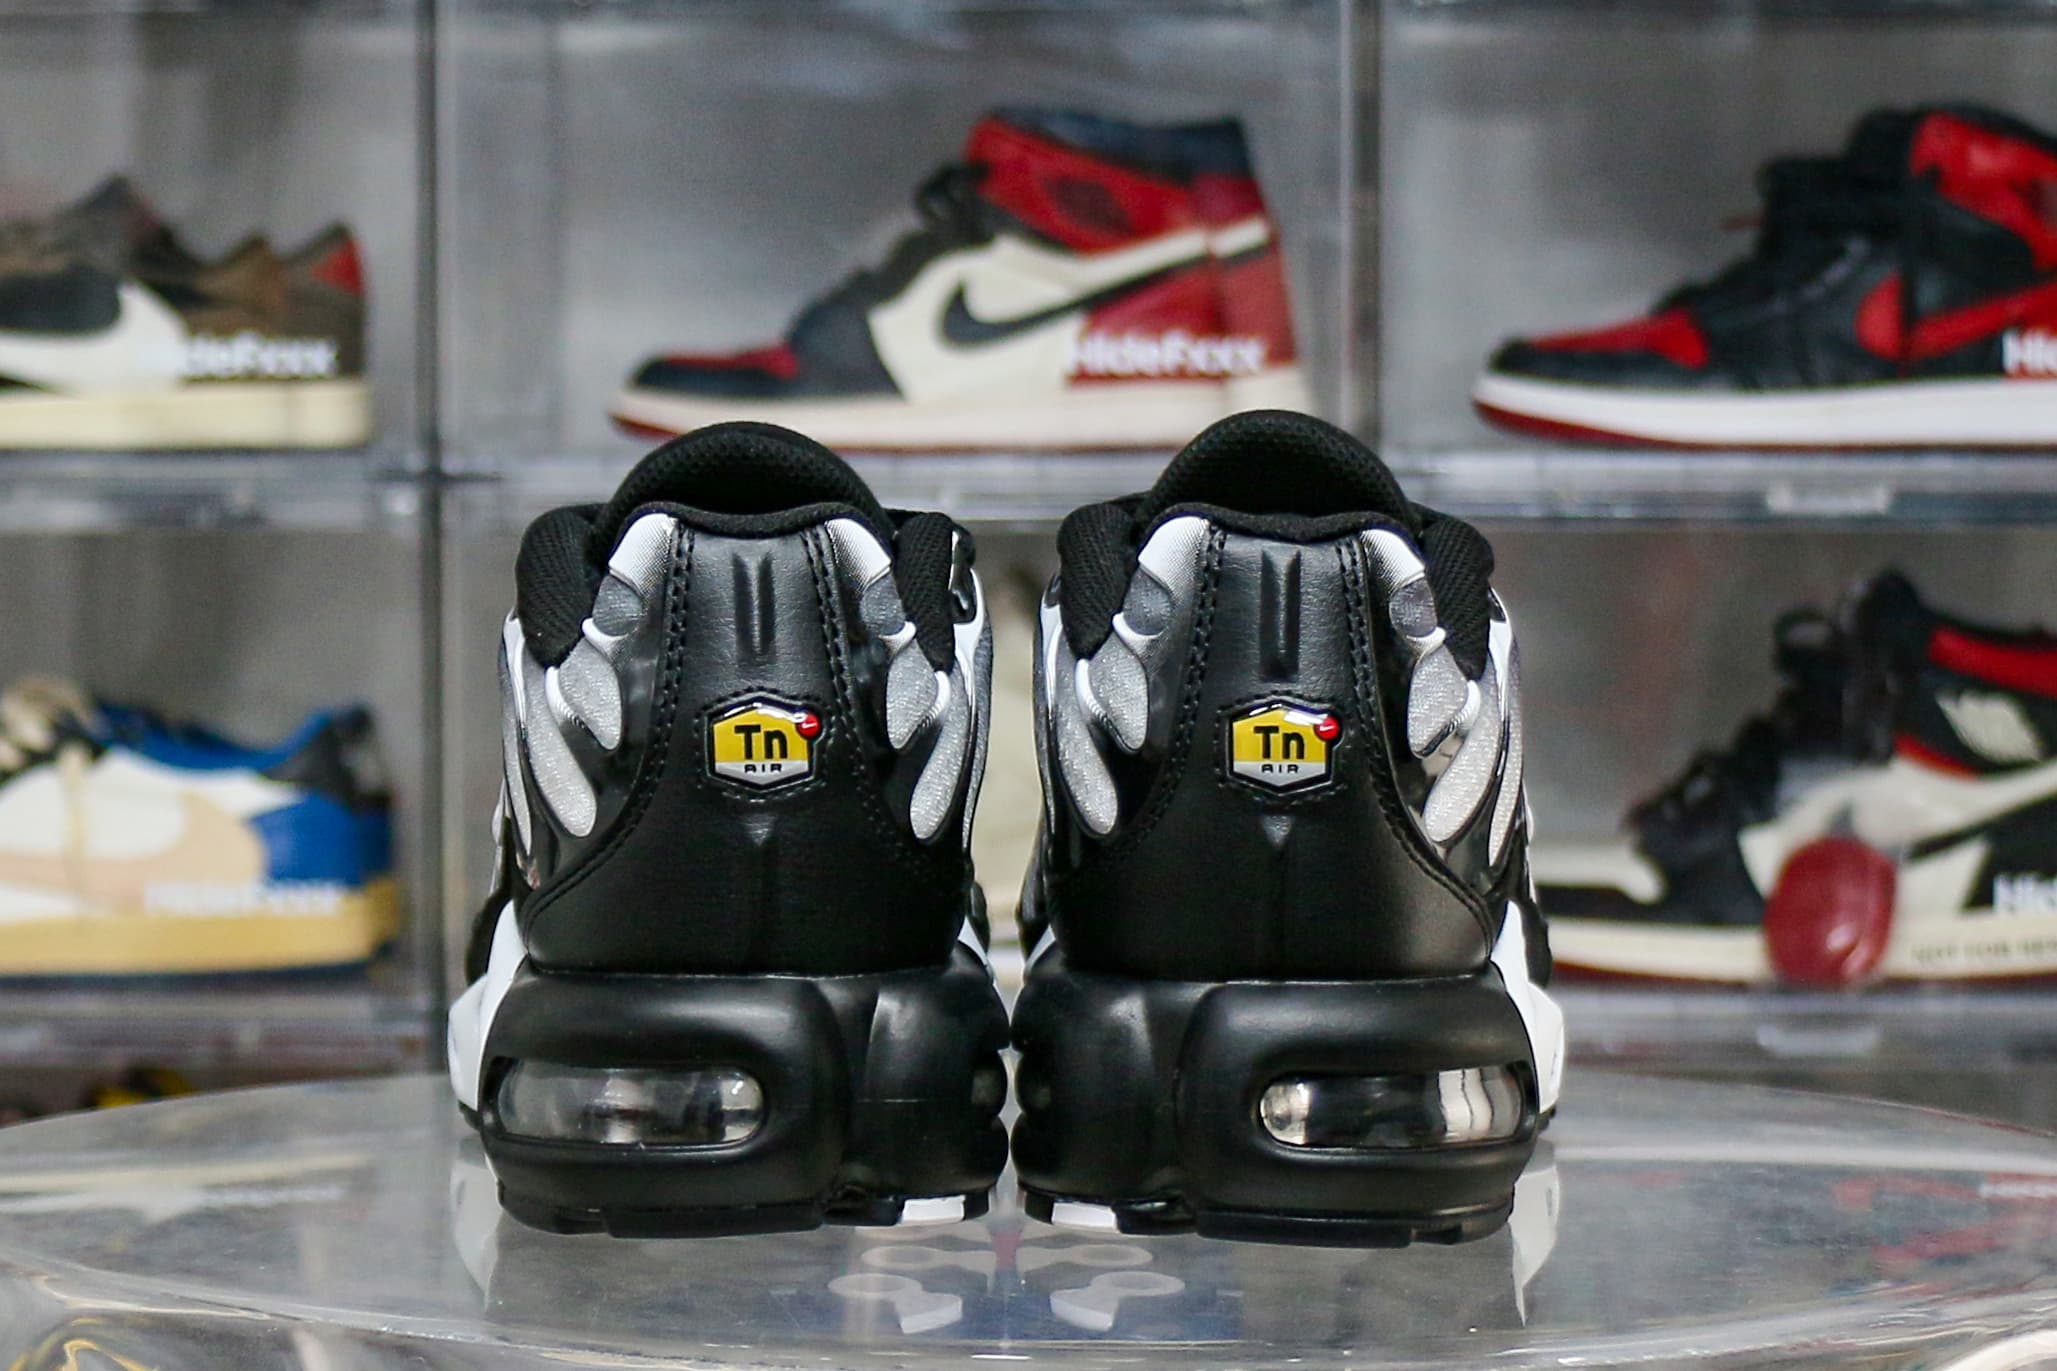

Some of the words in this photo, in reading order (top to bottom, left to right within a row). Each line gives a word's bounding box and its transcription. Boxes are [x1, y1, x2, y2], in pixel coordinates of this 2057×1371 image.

[734, 724, 788, 760] Tn
[1253, 725, 1305, 760] Tn
[744, 763, 782, 773] AIR
[1261, 764, 1299, 774] AIR
